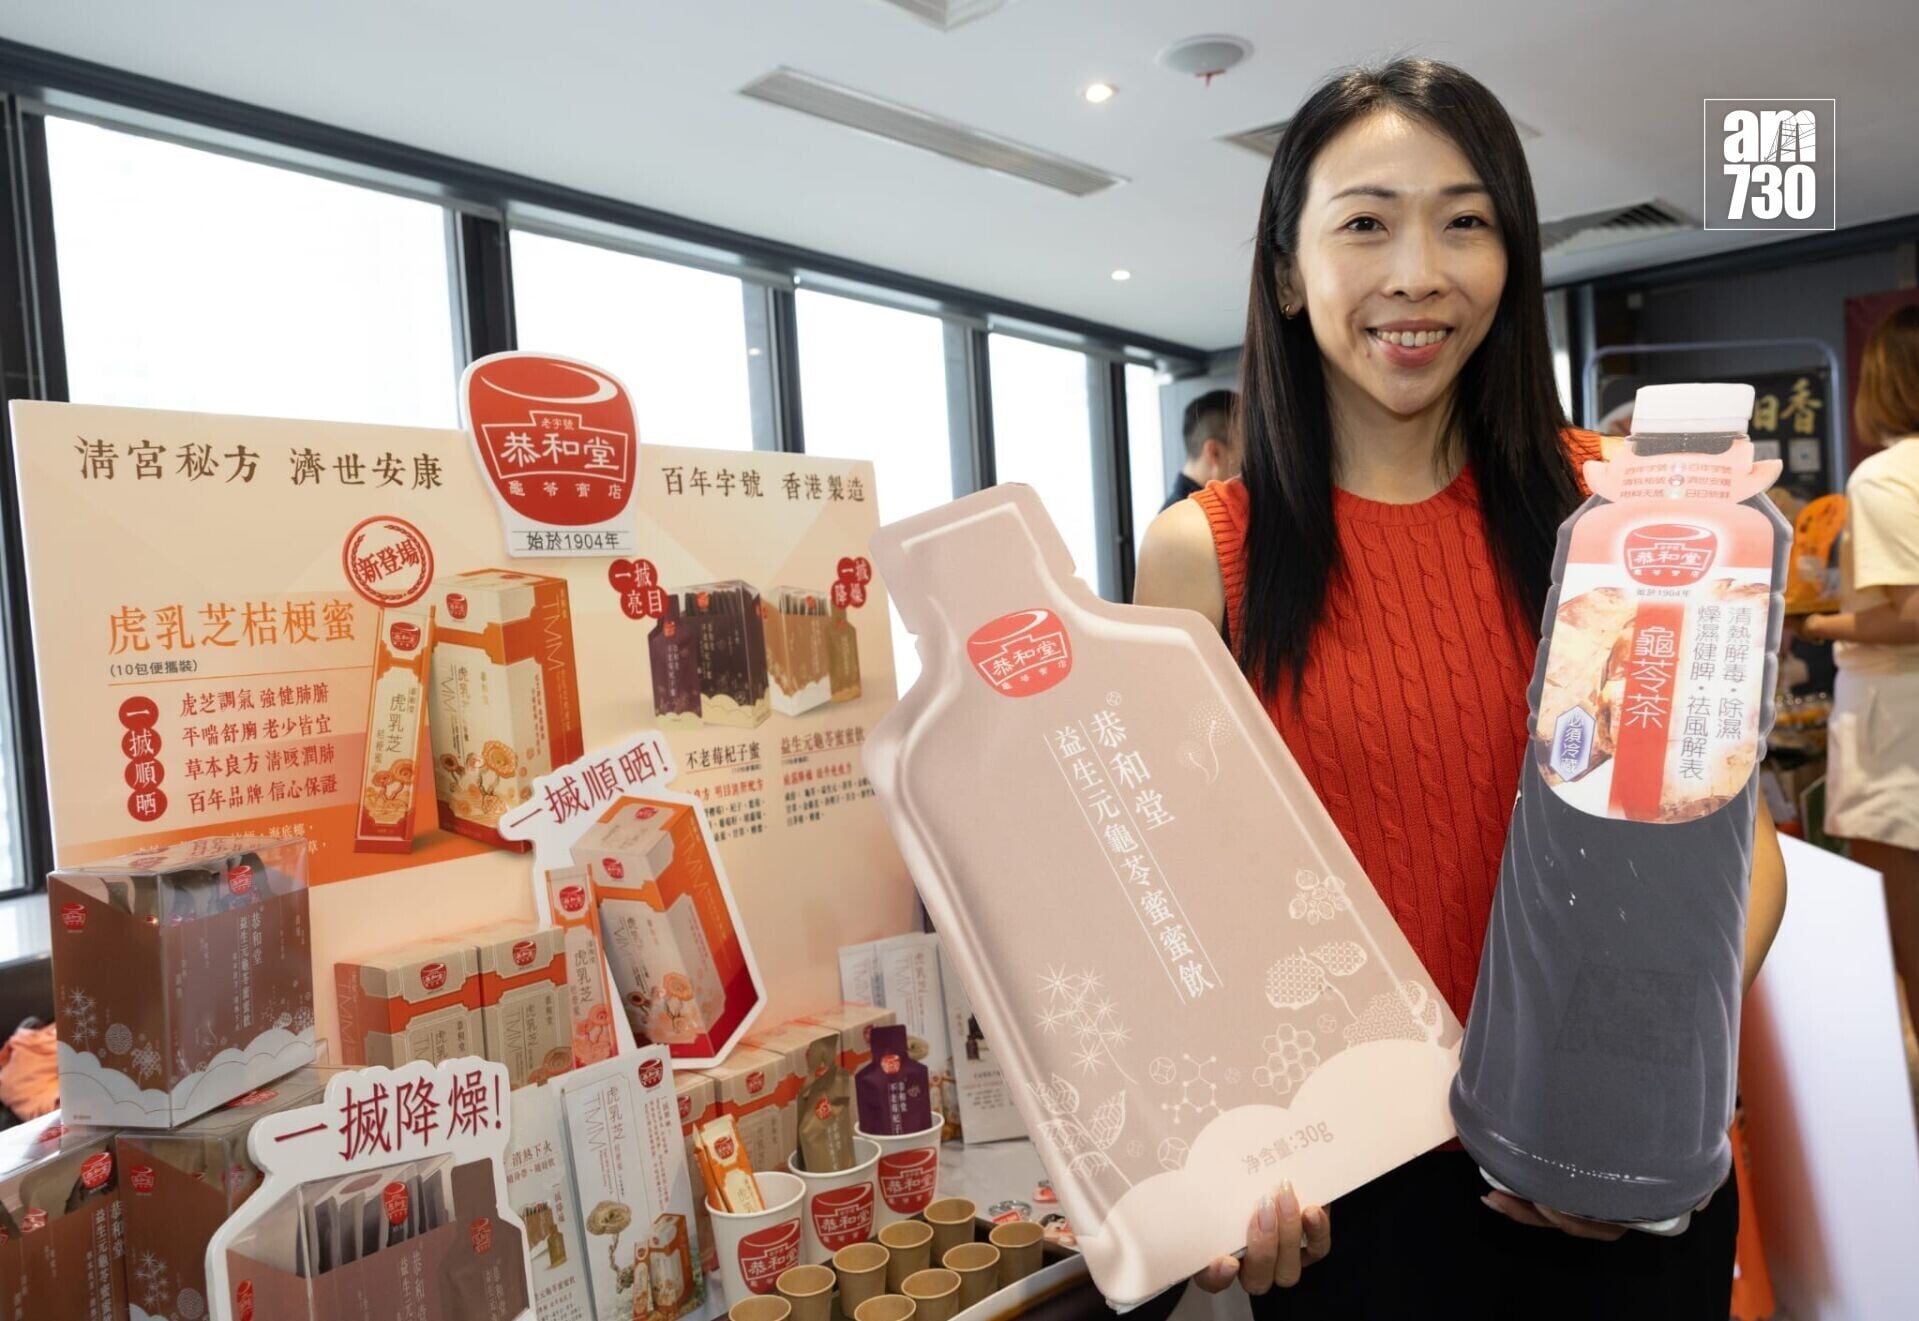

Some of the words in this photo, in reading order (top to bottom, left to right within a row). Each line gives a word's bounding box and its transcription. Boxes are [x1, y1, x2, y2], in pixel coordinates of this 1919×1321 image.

[74, 435, 261, 484] 清宮秘方
[290, 447, 443, 490] 濟世安康
[500, 431, 619, 470] 恭和堂
[662, 466, 764, 498] 百年字號
[781, 472, 865, 502] 香港製造
[527, 531, 620, 550] 始於1904年
[1634, 552, 1702, 566] 恭和堂
[354, 538, 422, 585] 新登場
[627, 590, 663, 615] 亮目
[107, 600, 356, 657] 虎乳芝桔梗蜜
[992, 640, 1061, 676] 恭和堂
[1625, 625, 1676, 729] 龜苓茶
[180, 688, 256, 718] 虎芝調氣
[259, 682, 329, 708] 強健肺腑
[182, 721, 257, 748] 平喘舒胸
[262, 713, 332, 740] 老少皆宜
[126, 708, 157, 816] 一搣順晒
[184, 751, 260, 781] 草本良方
[265, 743, 335, 771] 清咳潤肺
[685, 742, 760, 770] 不老莓杞子蜜
[1091, 709, 1176, 832] 恭和堂
[188, 783, 263, 814] 百年品牌
[270, 773, 338, 802] 信心保證
[510, 740, 669, 828] 一搣順晒!
[1054, 724, 1215, 999] 益生元龜苓蜜蜜飲
[274, 1070, 502, 1161] 一搣降燥!
[887, 1174, 933, 1193] 恭和堂
[821, 1210, 870, 1232] 恭和堂
